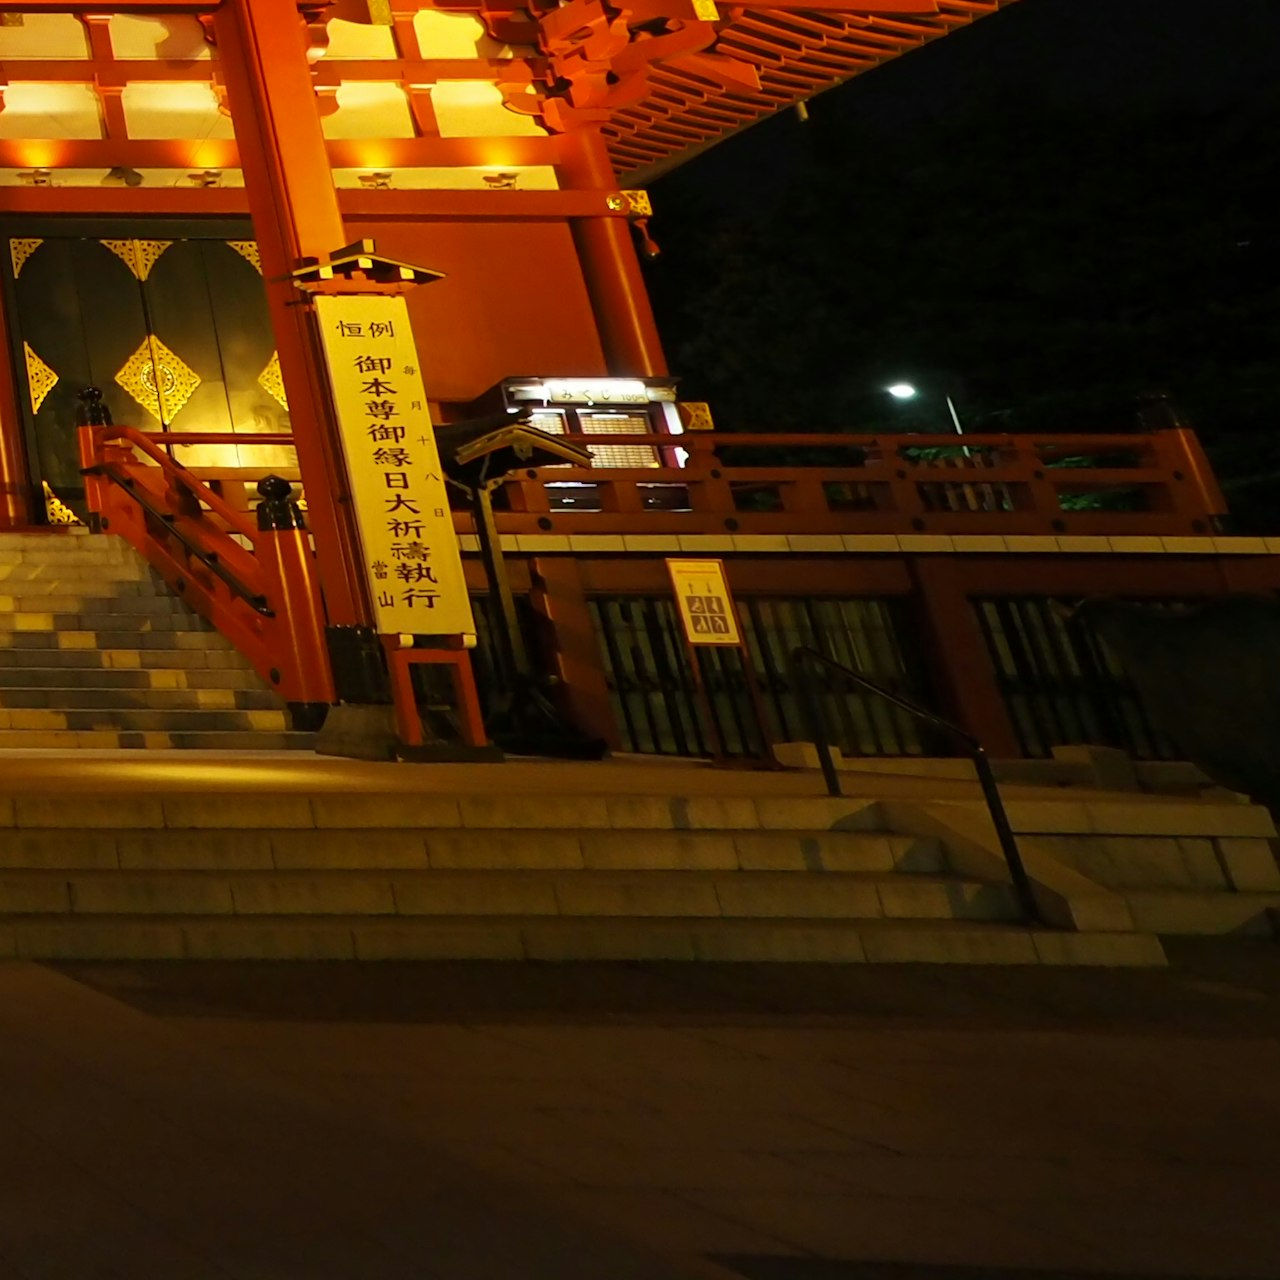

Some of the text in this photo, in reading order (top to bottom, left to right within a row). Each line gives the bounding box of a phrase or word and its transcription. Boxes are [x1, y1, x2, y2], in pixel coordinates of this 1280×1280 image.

[336, 320, 395, 338] 恒例
[403, 365, 445, 518] 毎月十八日
[371, 560, 395, 608] 當山
